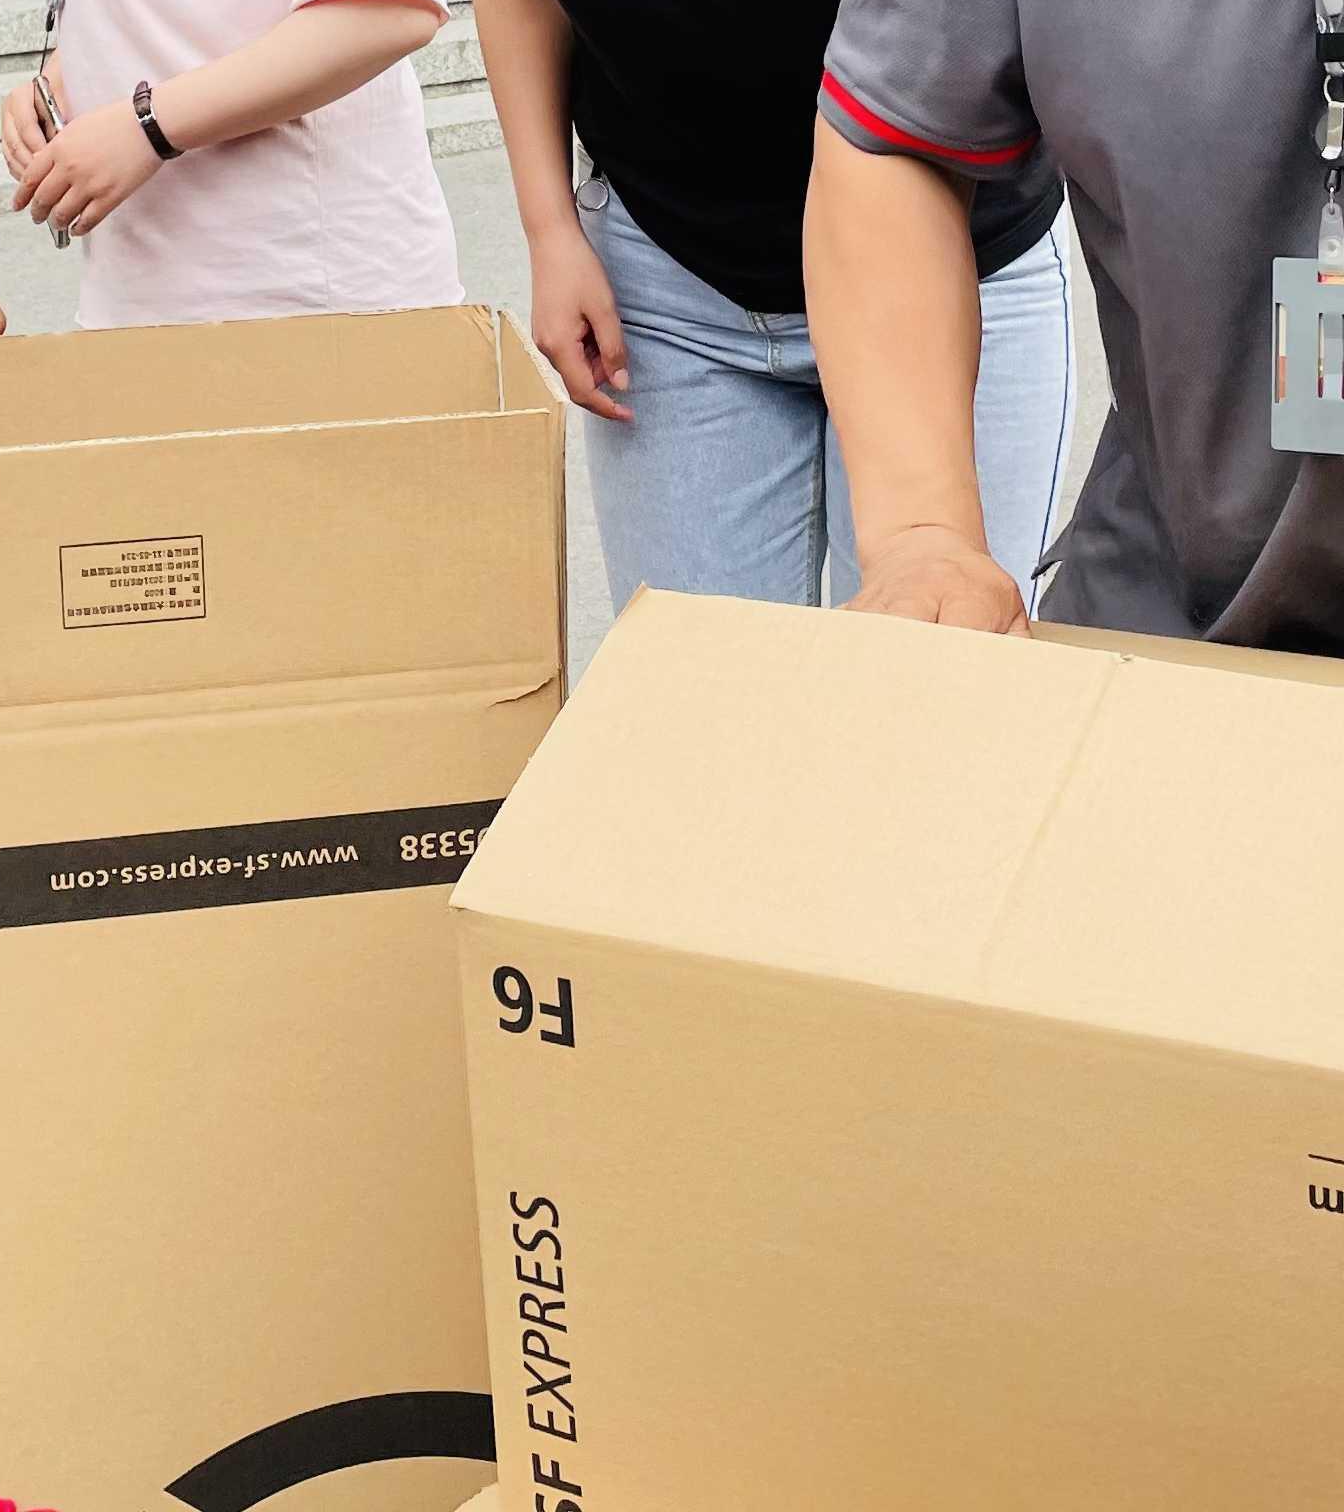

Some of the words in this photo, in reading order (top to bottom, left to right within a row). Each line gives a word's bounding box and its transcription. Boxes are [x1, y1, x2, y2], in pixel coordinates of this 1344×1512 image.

[49, 842, 359, 890] www.sf-express.com
[493, 966, 577, 1049] F6
[510, 1191, 578, 1443] EXPRESS
